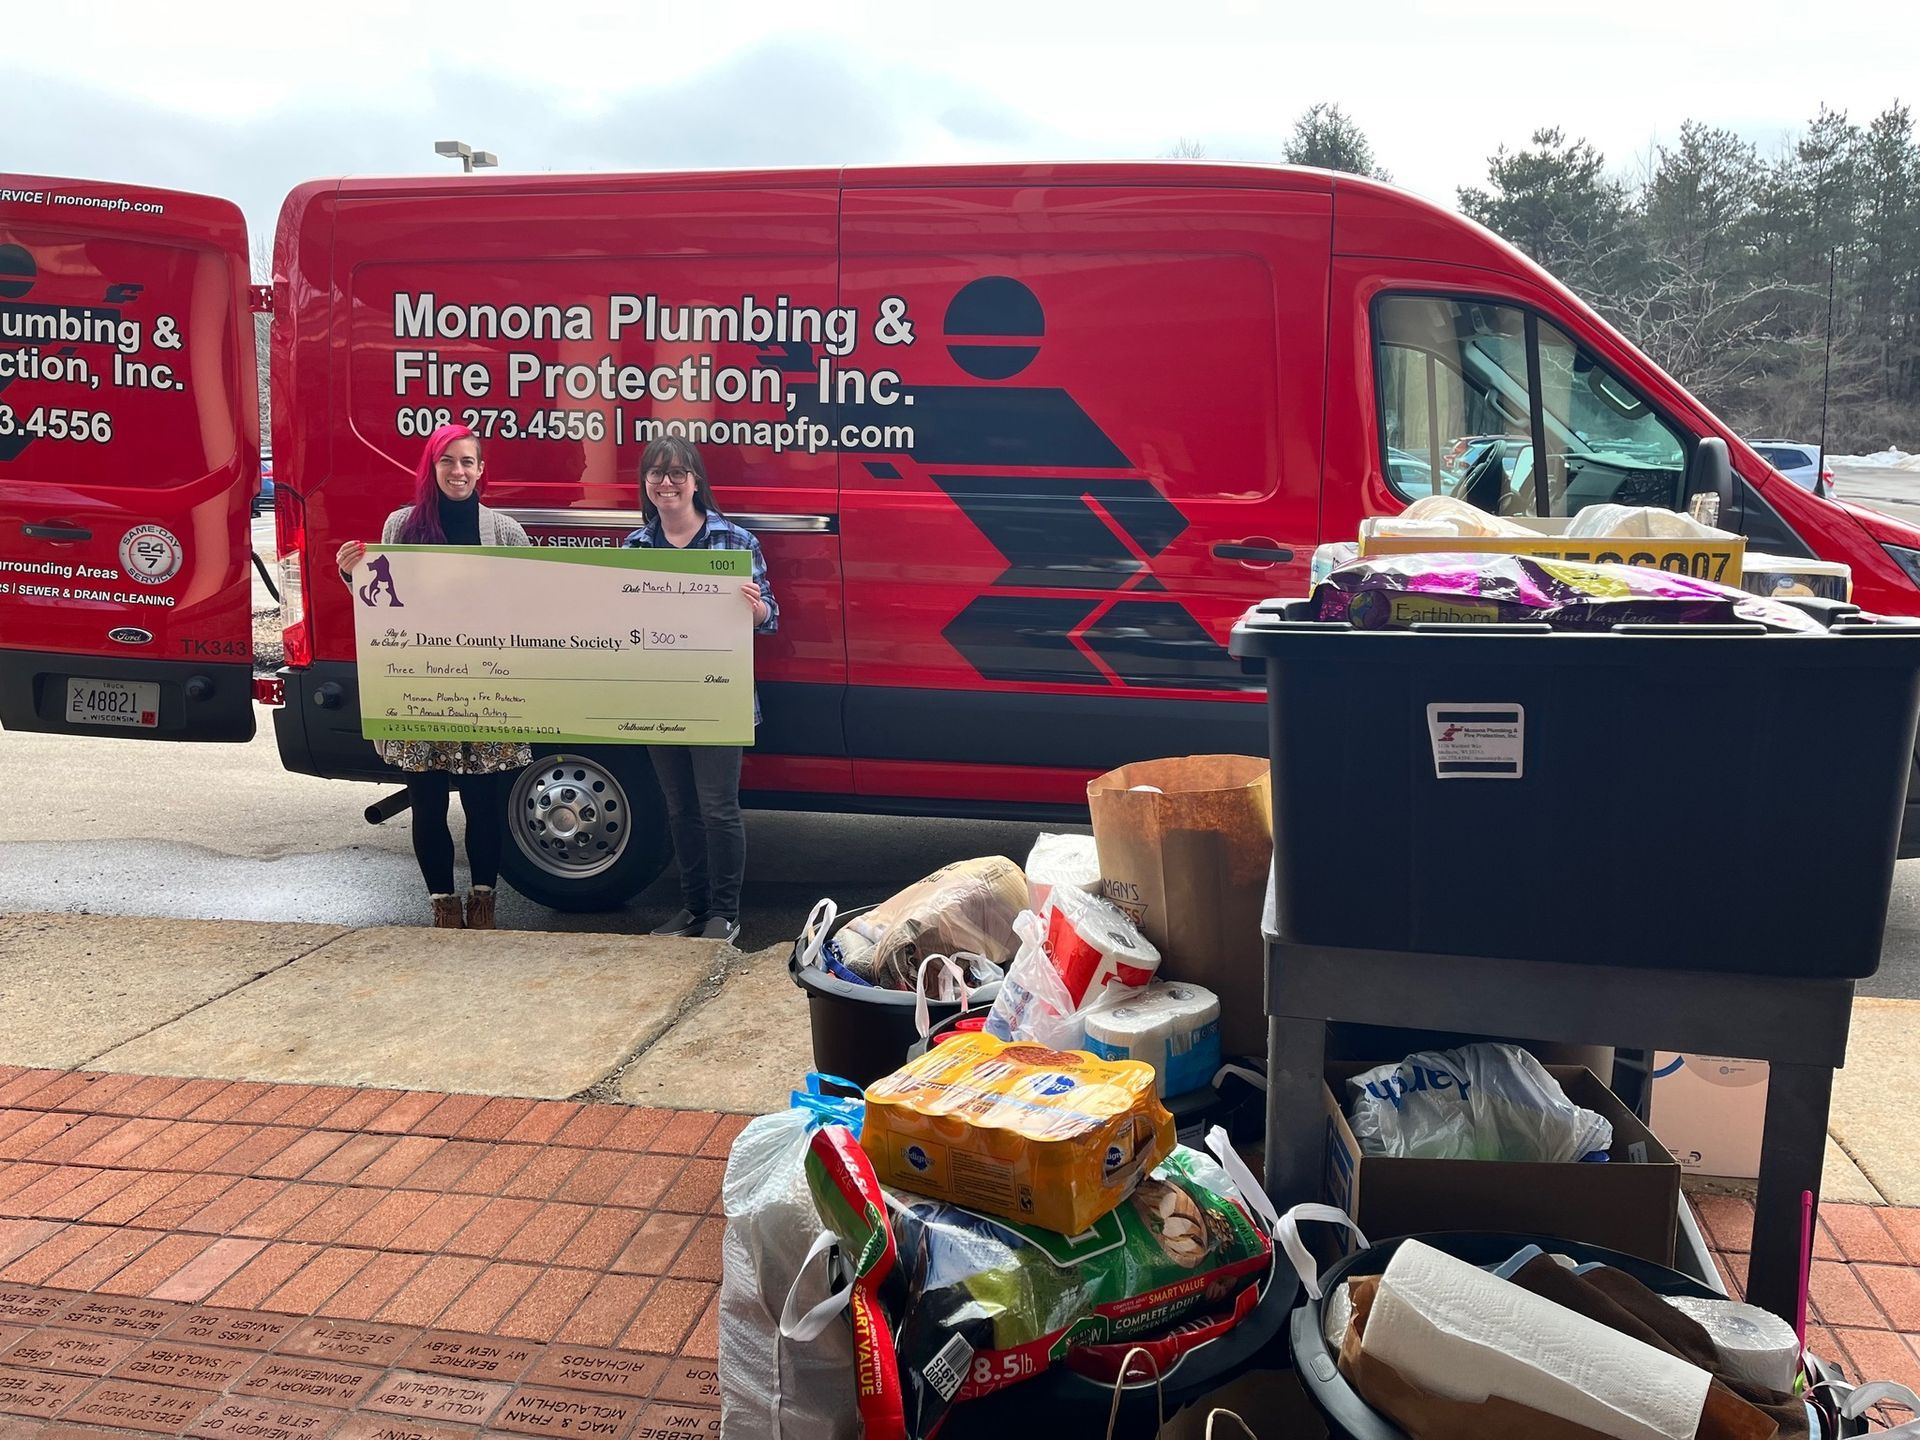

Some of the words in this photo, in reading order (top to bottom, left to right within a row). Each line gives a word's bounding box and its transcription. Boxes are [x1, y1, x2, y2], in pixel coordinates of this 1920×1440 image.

[54, 194, 165, 214] mononapfp.com
[393, 292, 593, 342] Monona
[608, 295, 858, 357] Plumbing
[873, 296, 915, 347] &
[152, 316, 183, 350] &
[113, 353, 185, 391] Inc.
[394, 351, 491, 398] Fire
[507, 352, 797, 412] Protection,
[818, 357, 916, 406] Inc.
[396, 406, 605, 443] 608273.4556
[635, 415, 915, 454] mononapfp.com
[137, 541, 166, 555] 24
[548, 536, 610, 548] SERVICE
[145, 557, 158, 569] 7
[709, 560, 735, 571] 1001
[76, 564, 119, 581] Areas
[127, 567, 175, 584] SERVICE
[621, 584, 642, 593] Date
[642, 581, 672, 592] March
[689, 582, 719, 593] 2023
[18, 585, 60, 598] SEWER
[62, 588, 71, 599] &
[74, 589, 110, 602] DRAIN
[113, 592, 175, 608] CLEANING
[1396, 602, 1491, 624] Earthborn
[116, 630, 143, 643] Ford
[384, 628, 399, 638] Pay
[400, 629, 408, 637] to
[630, 629, 641, 645] $
[651, 631, 676, 645] 300
[180, 639, 248, 657] TK343
[370, 638, 381, 647] the
[381, 638, 400, 647] Order
[400, 638, 411, 649] of
[416, 633, 452, 647] Dane
[456, 634, 506, 650] County
[510, 634, 566, 648] Humane
[570, 635, 623, 652] Society
[387, 662, 416, 675] Three
[426, 661, 469, 675] hundred
[103, 682, 125, 690] TRUCK
[703, 674, 730, 684] Dollars
[86, 689, 137, 714] 48821
[402, 692, 433, 702] Monona
[495, 692, 526, 703] Protection
[90, 714, 135, 722] WISCONSIN
[419, 706, 445, 717] Annual
[448, 706, 479, 726] Bowling
[482, 706, 508, 725] Outing
[618, 723, 655, 732] Authorized
[656, 723, 686, 733] Signature
[1148, 1286, 1178, 1305] SMART
[1178, 1277, 1205, 1295] VALUE
[34, 1297, 66, 1307] SUE
[0, 1304, 50, 1318] GEORG
[853, 1283, 870, 1337] SMART
[64, 1312, 105, 1325] SALES
[114, 1318, 161, 1331] BETHEL
[1115, 1306, 1168, 1330] COMPLETE
[184, 1326, 213, 1338] YOU
[870, 1322, 879, 1347] ADULT
[1128, 1320, 1160, 1336] CHICKEN
[218, 1331, 253, 1342] MISS
[313, 1328, 395, 1345] STENSETH
[54, 1339, 100, 1351] WALSH
[422, 1340, 462, 1352] BABY
[465, 1347, 500, 1358] NEW
[13, 1348, 53, 1363] GREG
[66, 1354, 113, 1368] TERRY
[146, 1350, 222, 1368] SMOLAREK
[430, 1354, 499, 1371] BEATRICE
[504, 1351, 529, 1361] MY
[129, 1361, 175, 1376] LOVED
[561, 1355, 646, 1372] RICHARDS
[858, 1338, 874, 1396] VALUE
[178, 1368, 233, 1382] ALWAYS
[559, 1369, 630, 1385] LINDSAY
[873, 1350, 882, 1394] NUTRITION
[933, 1357, 960, 1389] 14915
[35, 1382, 66, 1395] THE
[246, 1377, 269, 1388] OF
[273, 1380, 335, 1398] MEMORY
[925, 1366, 951, 1399] 17800
[338, 1389, 356, 1400] IN
[394, 1381, 489, 1401] MCLAUGHLIN
[375, 1393, 416, 1407] RUBY
[422, 1400, 433, 1409] &
[222, 1405, 251, 1418] YRS
[437, 1403, 486, 1416] MOLLY
[516, 1396, 627, 1421] MCLAUGHLIN
[200, 1418, 225, 1431] OF
[277, 1414, 320, 1429] JETTA
[505, 1409, 551, 1426] FRAN
[561, 1417, 573, 1429] &
[665, 1415, 701, 1428] NIKI
[226, 1423, 296, 1440] MEMORY
[578, 1422, 619, 1435] MAC
